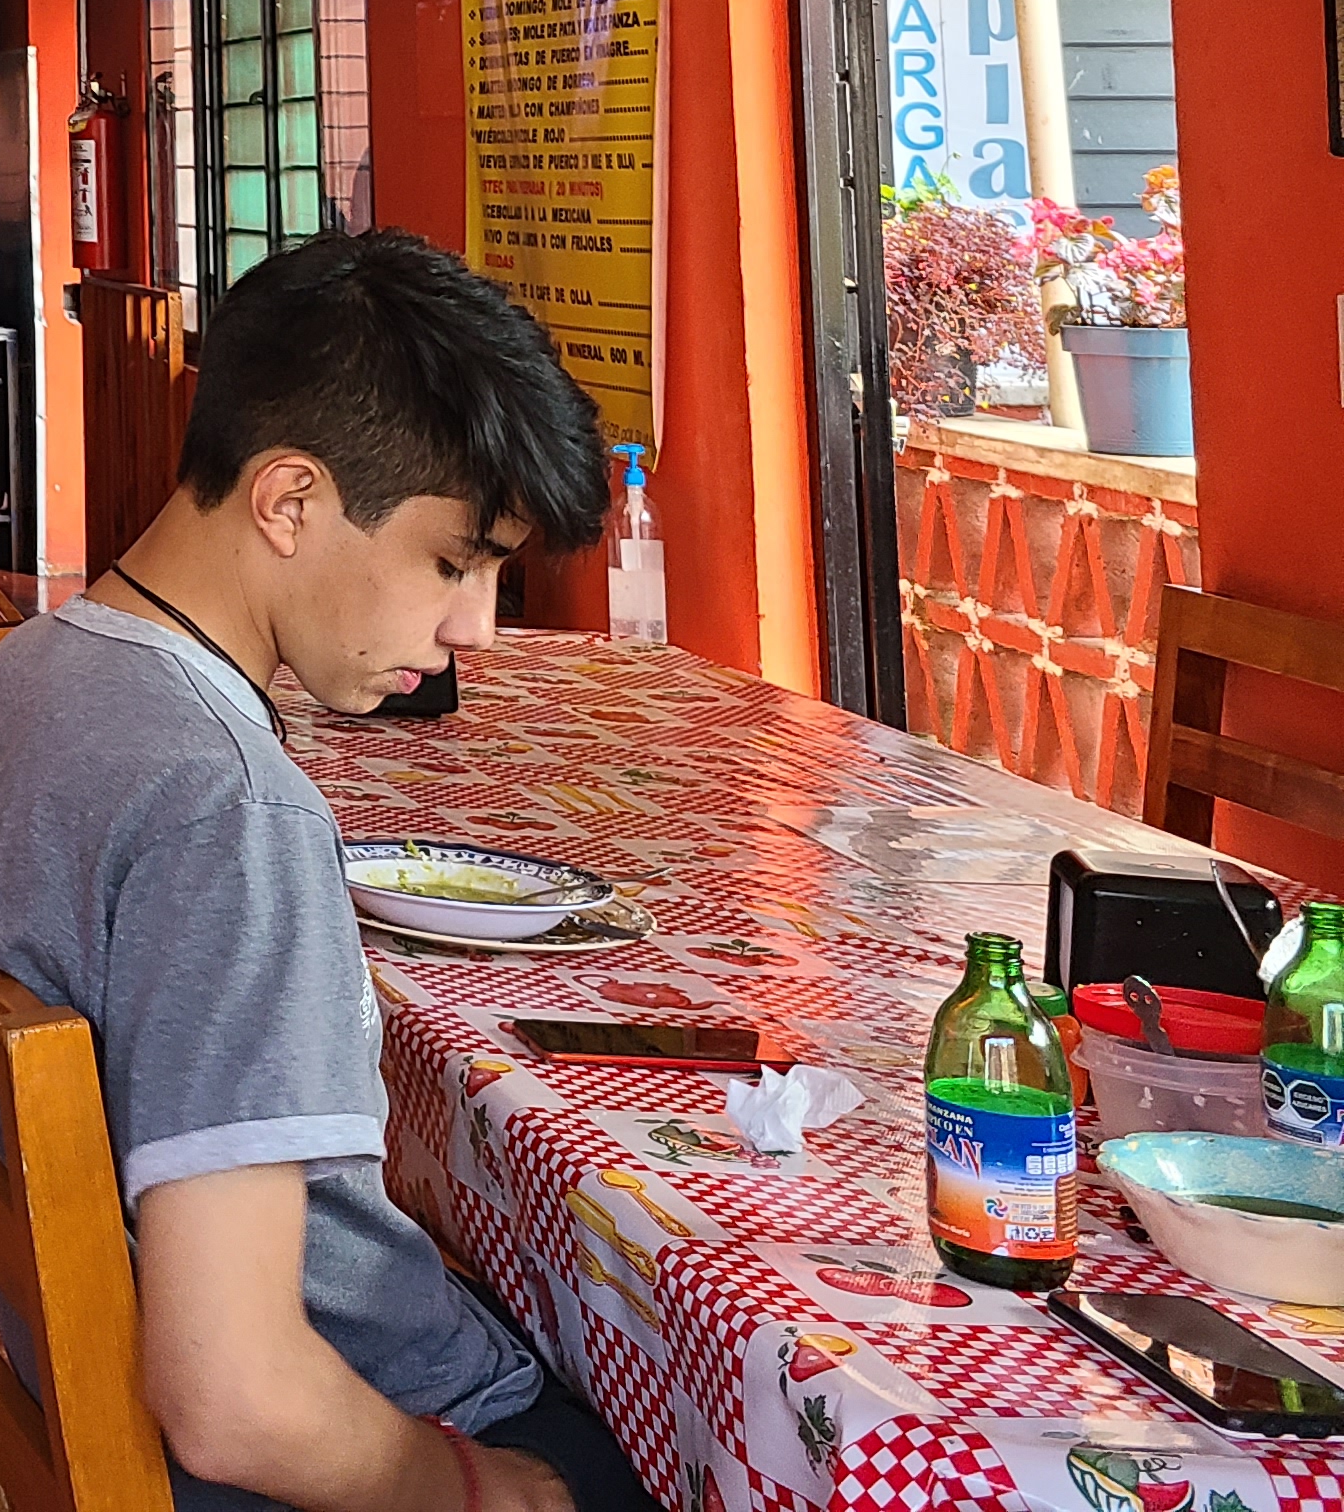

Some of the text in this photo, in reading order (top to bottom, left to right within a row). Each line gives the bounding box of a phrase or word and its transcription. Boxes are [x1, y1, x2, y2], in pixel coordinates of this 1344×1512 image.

[523, 22, 545, 40] MOLE
[547, 21, 558, 39] DE
[559, 19, 577, 38] PATA
[608, 11, 641, 32] PANZA
[535, 50, 546, 65] DE
[551, 47, 580, 65] PUERCO
[547, 75, 558, 91] DE
[524, 102, 544, 118] CON
[543, 128, 566, 143] ROJO
[533, 154, 544, 170] DE
[550, 233, 566, 250] CON
[555, 287, 565, 303] DE
[570, 289, 593, 306] OLLA
[566, 342, 605, 362] MINERAL
[610, 347, 627, 365] 600
